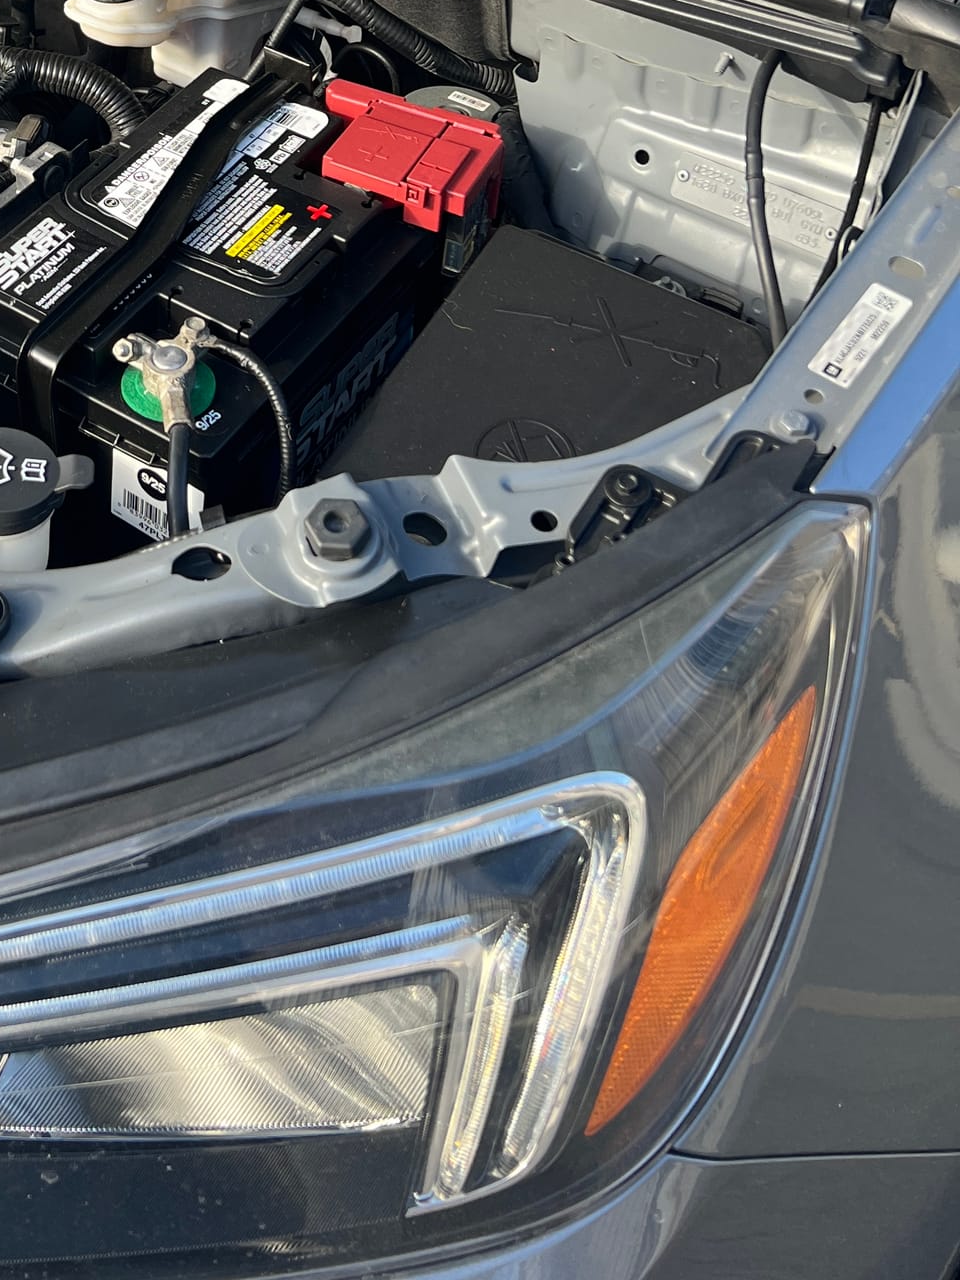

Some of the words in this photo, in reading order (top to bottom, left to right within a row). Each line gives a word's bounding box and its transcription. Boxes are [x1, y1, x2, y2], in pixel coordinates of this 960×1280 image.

[13, 242, 76, 296] PLATINUM
[195, 409, 222, 431] 9/25
[140, 472, 166, 494] 9/25
